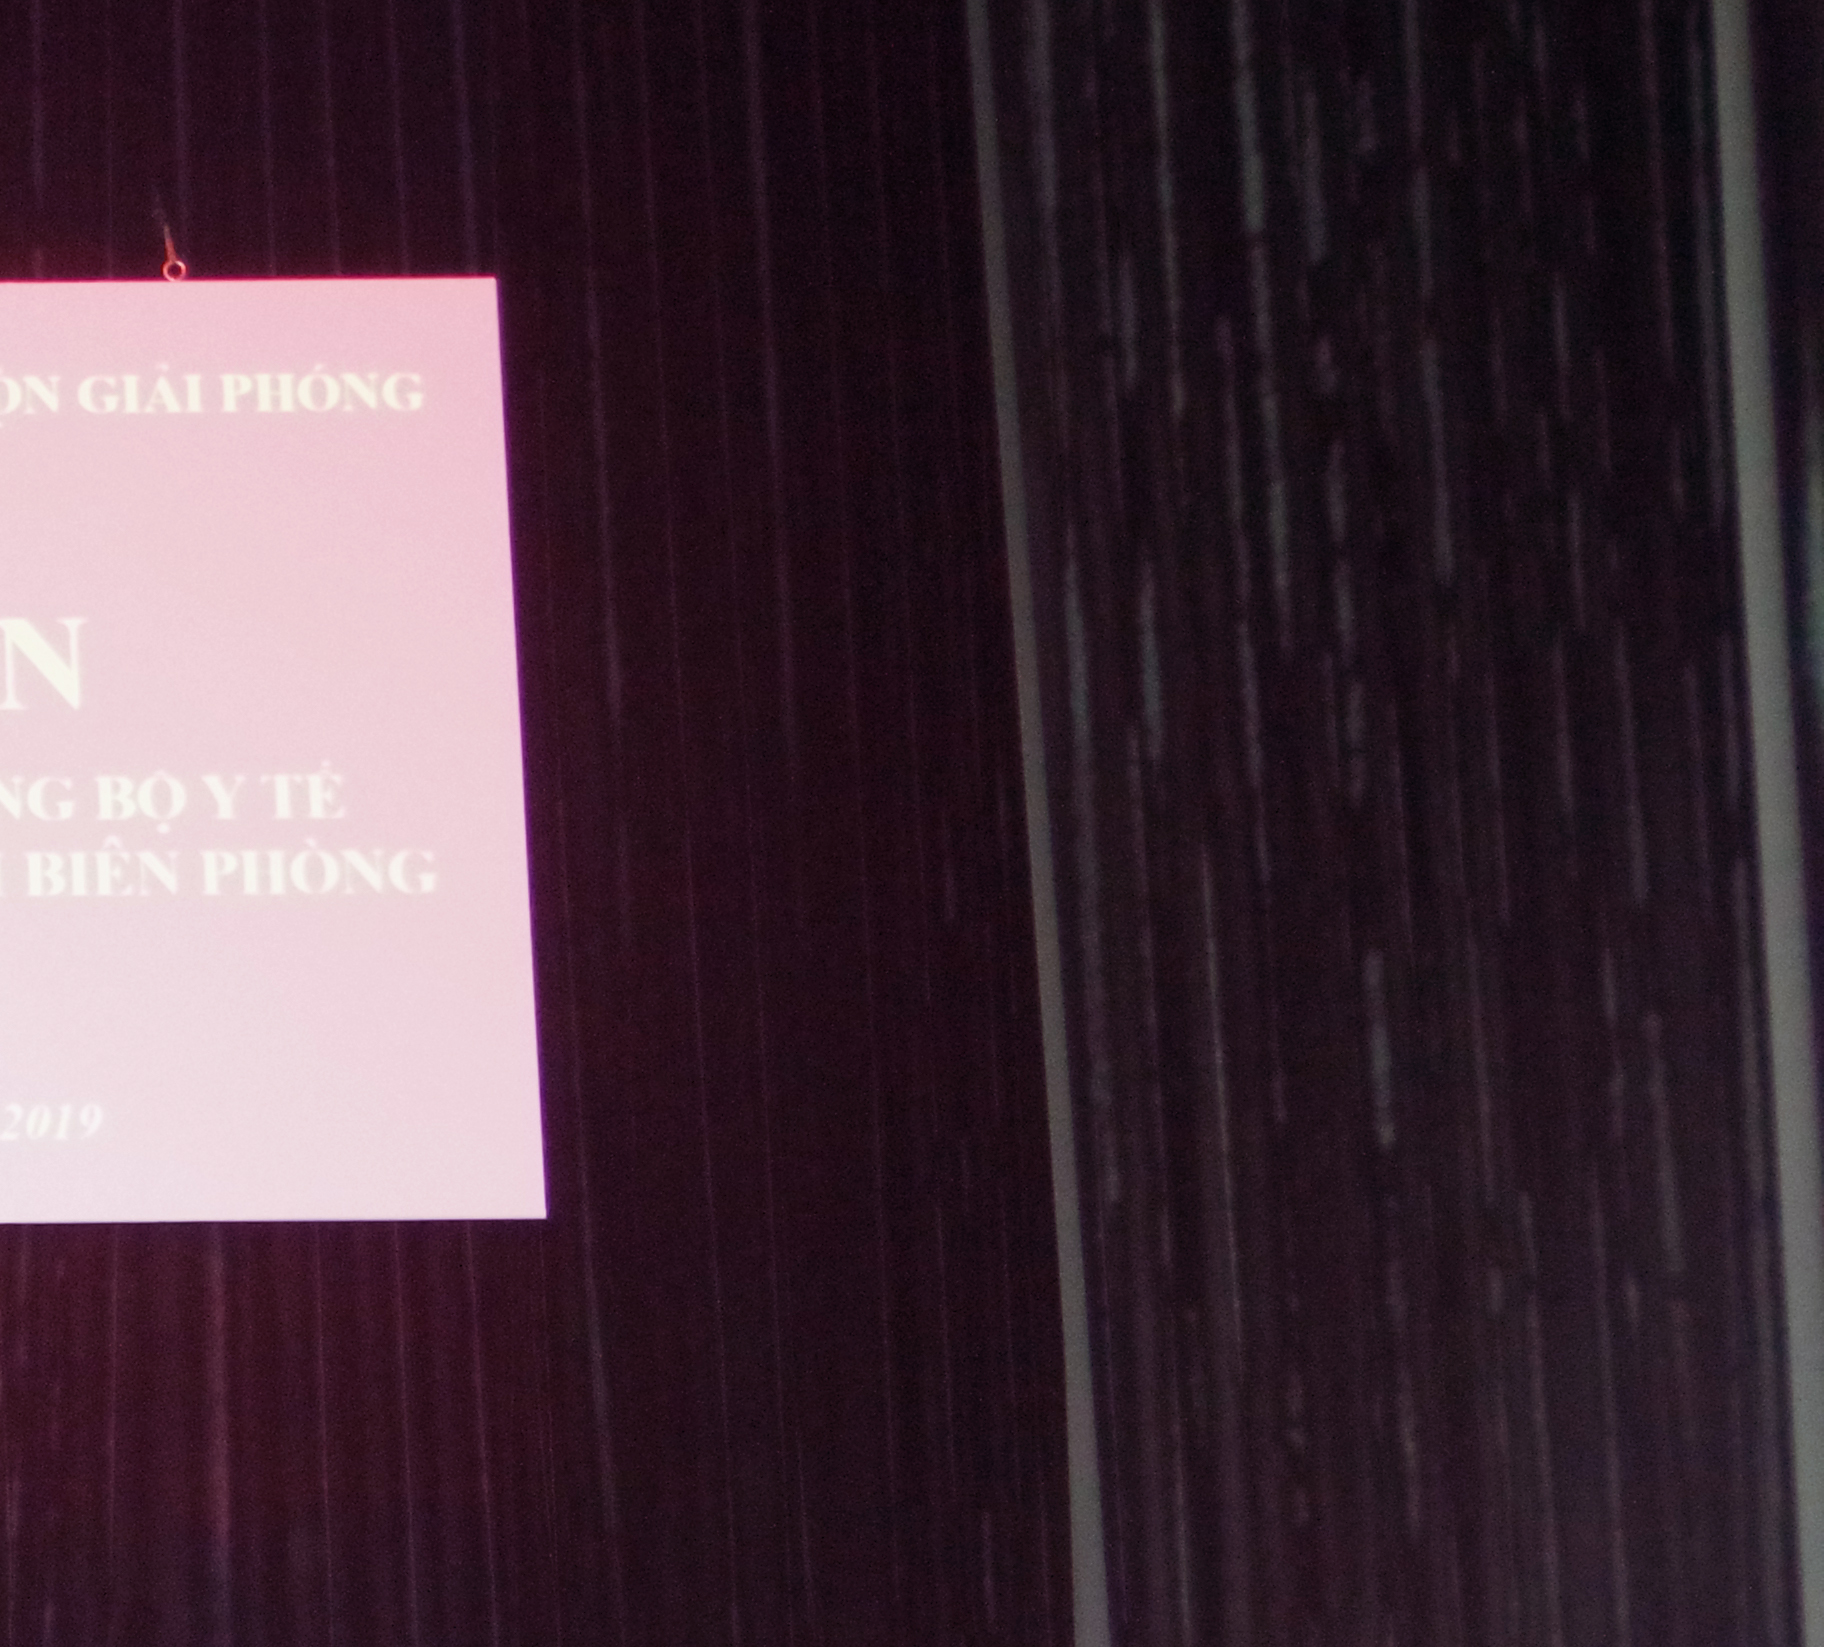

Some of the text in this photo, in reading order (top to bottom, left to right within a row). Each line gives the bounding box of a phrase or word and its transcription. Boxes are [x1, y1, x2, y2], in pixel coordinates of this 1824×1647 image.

[78, 363, 204, 414] GIẢI
[219, 362, 424, 413] PHÓNG
[95, 770, 186, 833] BỘ
[201, 774, 248, 821] Y
[261, 760, 347, 821] TẾ
[26, 834, 182, 898] BIÊN
[201, 837, 438, 895] PHÒNG
